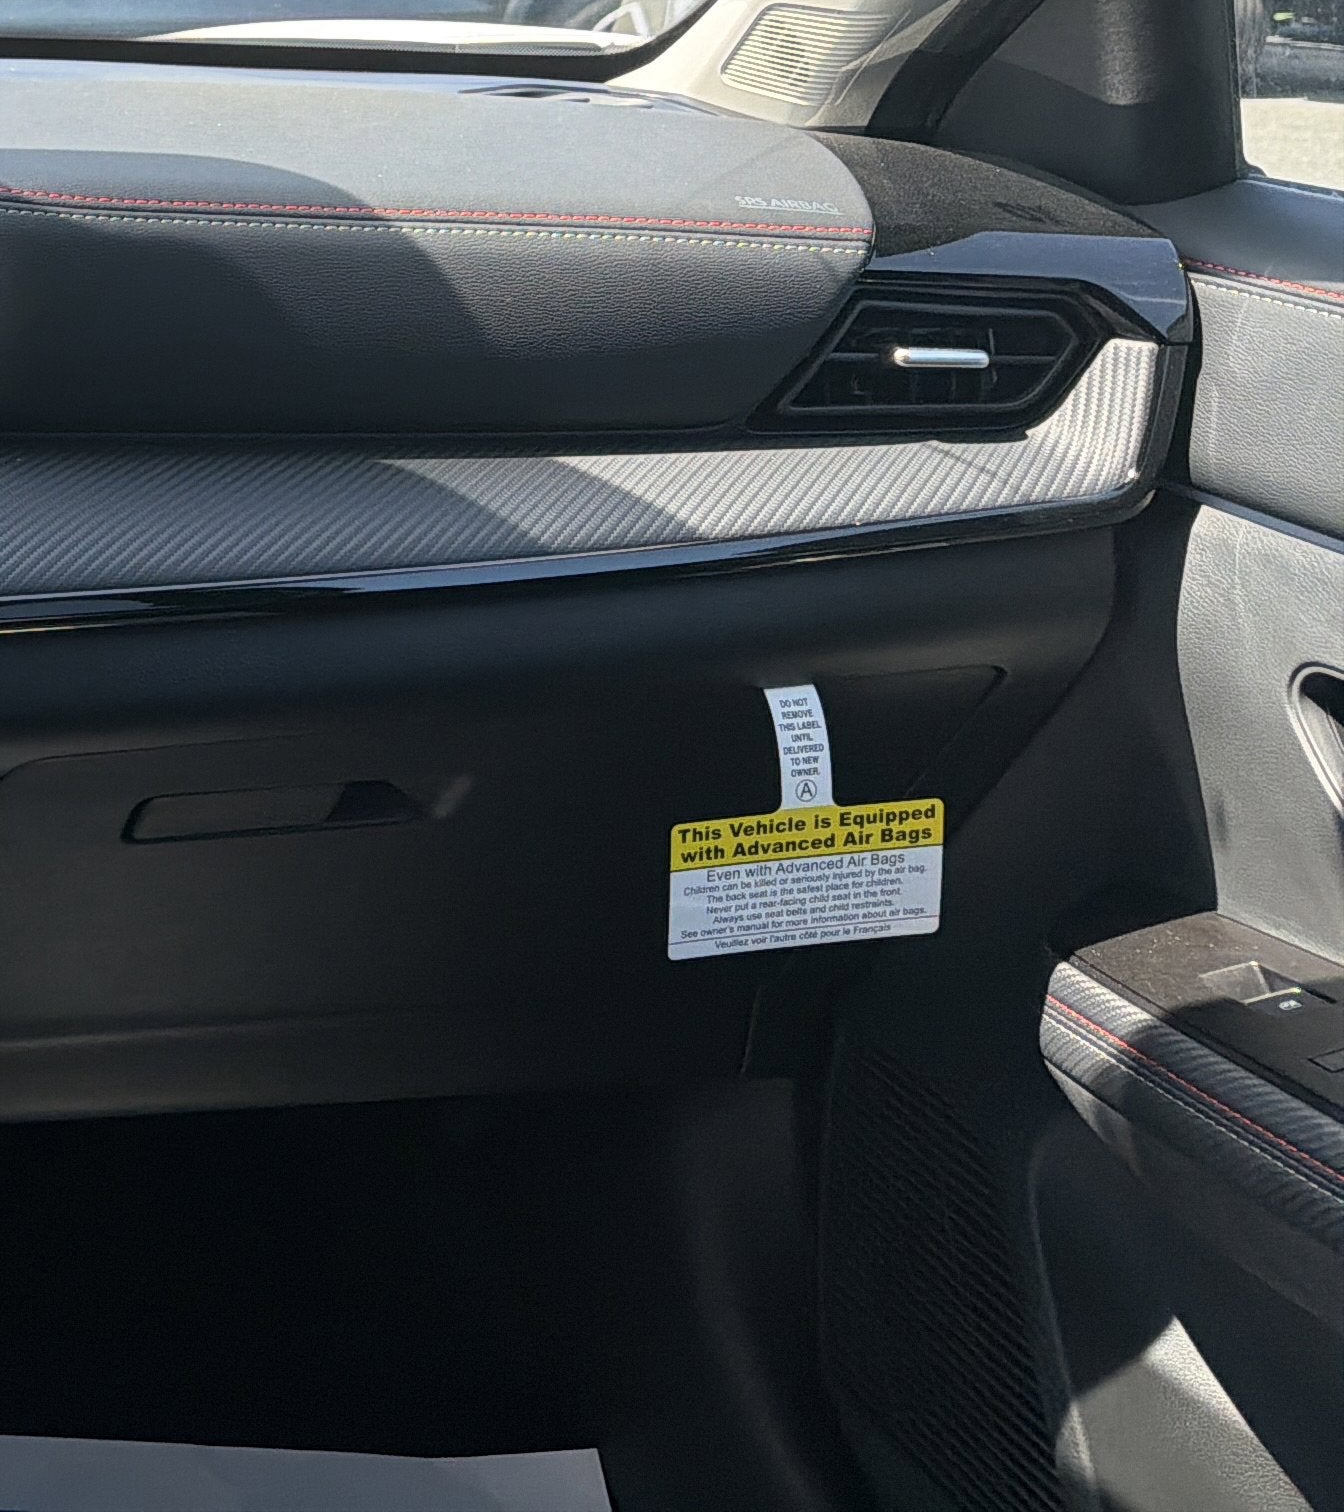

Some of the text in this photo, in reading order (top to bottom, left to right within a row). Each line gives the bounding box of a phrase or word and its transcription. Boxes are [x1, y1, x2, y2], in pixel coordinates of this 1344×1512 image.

[734, 195, 839, 212] SRS AIRBAG
[779, 698, 808, 708] DO NOT
[781, 709, 814, 720] REMOVE
[778, 721, 822, 731] THIS LABEL
[791, 733, 814, 742] UNTIL
[783, 744, 824, 755] DELIVERED
[790, 756, 819, 766] TO NEW
[801, 782, 813, 798] A
[678, 804, 936, 844] This Vehicle is Equipped
[680, 827, 933, 864] with Advanced Air Bags
[707, 853, 905, 882] Even with Advanced Air Bags
[683, 885, 720, 896] Children
[722, 883, 738, 891] can
[754, 878, 776, 888] killed
[791, 873, 830, 884] seriously
[833, 869, 862, 882] injured
[865, 869, 876, 878] by
[908, 865, 927, 874] bag.
[707, 895, 723, 904] The
[726, 892, 746, 901] back
[749, 890, 768, 899] seat
[770, 889, 777, 897] is
[780, 886, 794, 895] the
[796, 883, 823, 893] safest
[826, 882, 849, 893] place
[866, 878, 903, 887] children.
[715, 938, 748, 949] Veuillez
[751, 936, 767, 944] voir
[820, 927, 840, 939] pour
[843, 926, 850, 934] le
[853, 924, 891, 934] Français
